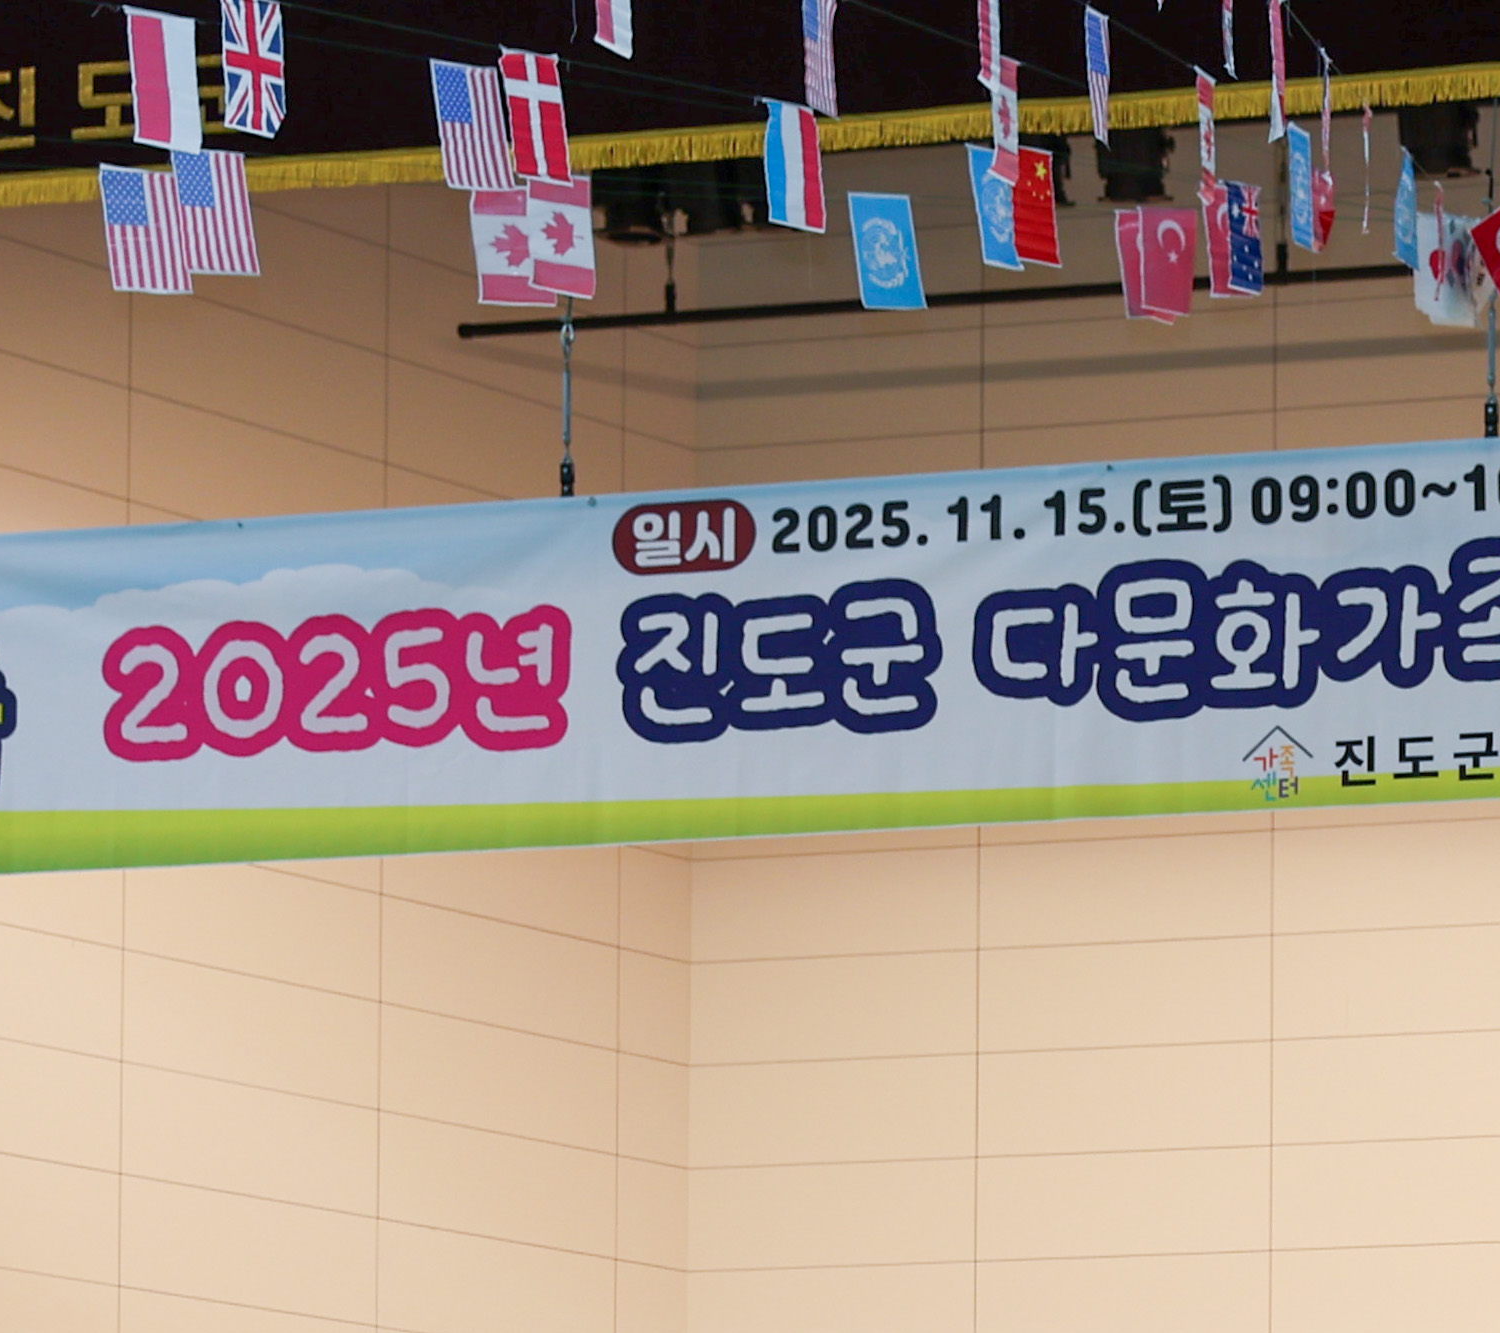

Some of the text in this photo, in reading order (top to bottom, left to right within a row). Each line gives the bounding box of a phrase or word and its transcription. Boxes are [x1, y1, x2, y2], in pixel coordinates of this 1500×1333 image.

[631, 506, 737, 568] 일시
[771, 501, 928, 554] 2025.
[947, 494, 1026, 542] 11.
[106, 609, 565, 757] 2025년
[623, 585, 936, 739] 진도군
